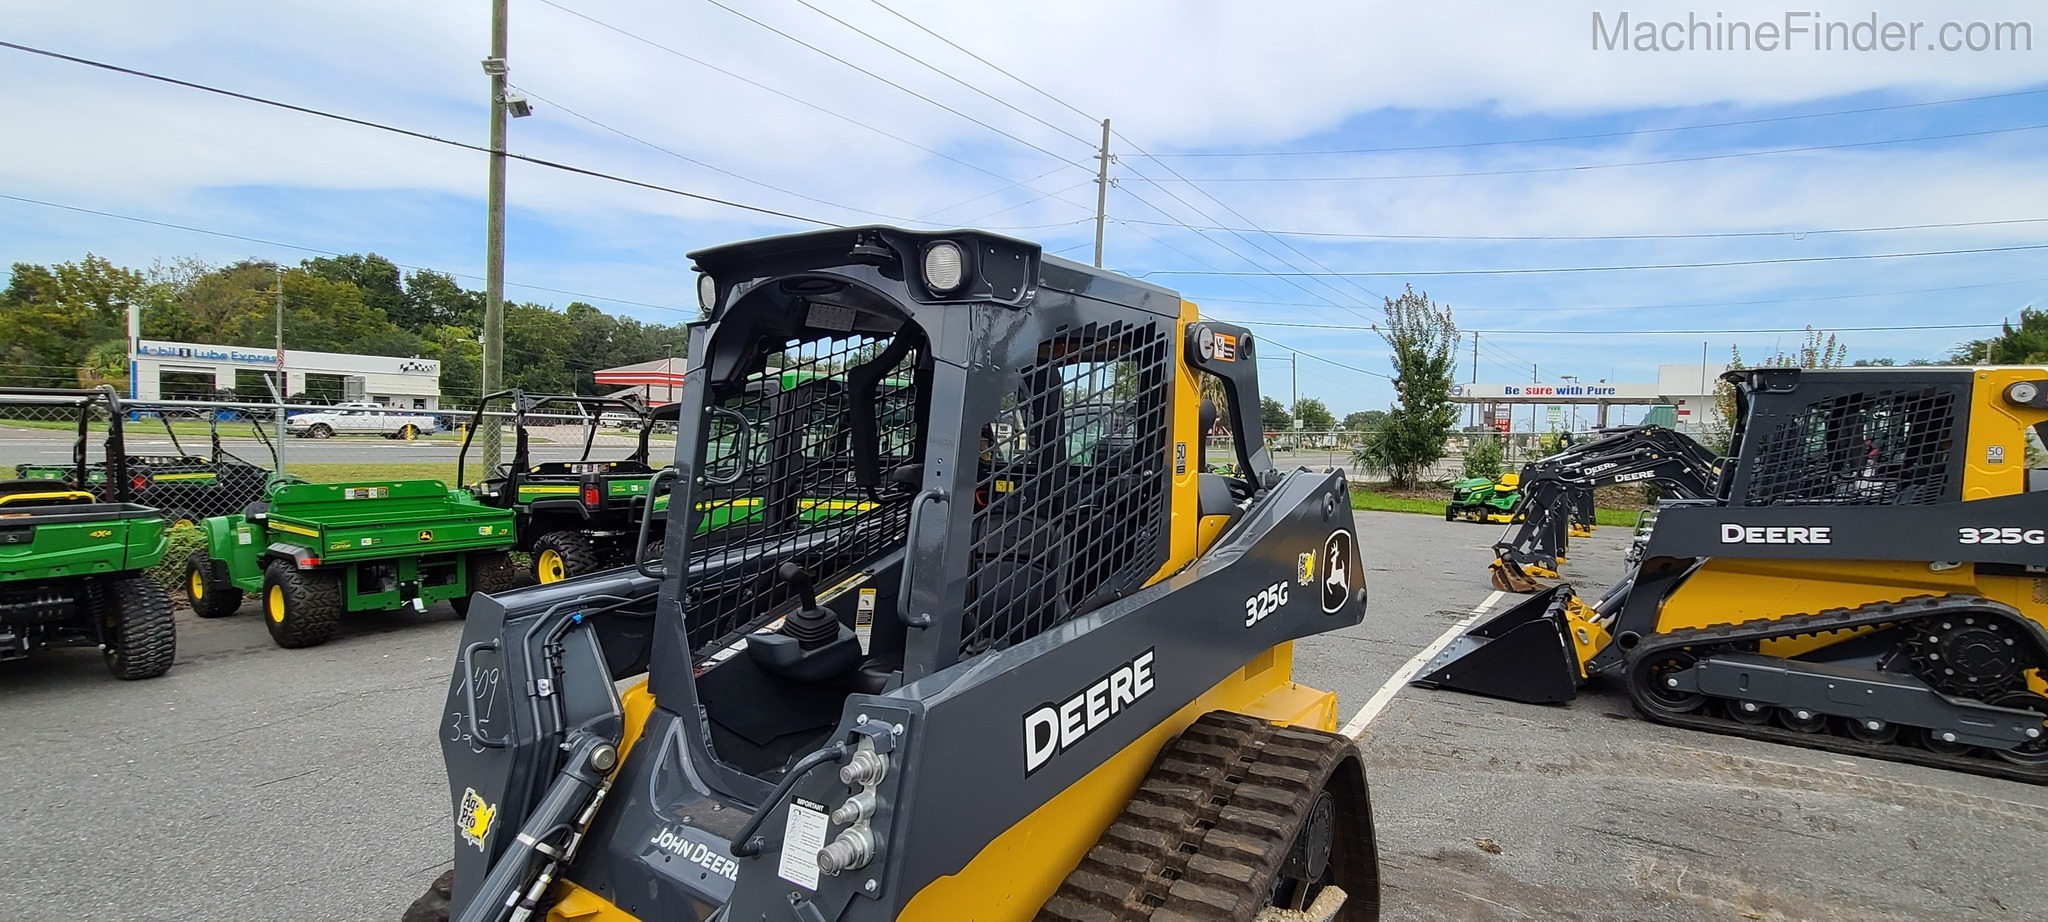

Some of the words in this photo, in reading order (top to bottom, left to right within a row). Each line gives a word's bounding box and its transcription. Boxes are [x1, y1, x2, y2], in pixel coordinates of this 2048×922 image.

[194, 348, 228, 361] Lube
[231, 350, 278, 364] Expres
[1504, 386, 1520, 395] Be
[1525, 386, 1553, 396] sure
[1556, 385, 1583, 395] with
[1586, 386, 1616, 396] Pure
[1176, 444, 1186, 460] 50
[1988, 446, 2003, 456] 50
[1583, 462, 1618, 476] DEERE
[1614, 470, 1656, 483] DEERE
[1721, 523, 1831, 544] DEERE
[1958, 527, 2046, 545] 325G
[1245, 581, 1288, 628] 325G
[1025, 650, 1155, 773] DEERE
[796, 798, 825, 812] IMPORTANT
[650, 827, 695, 859] JOHN
